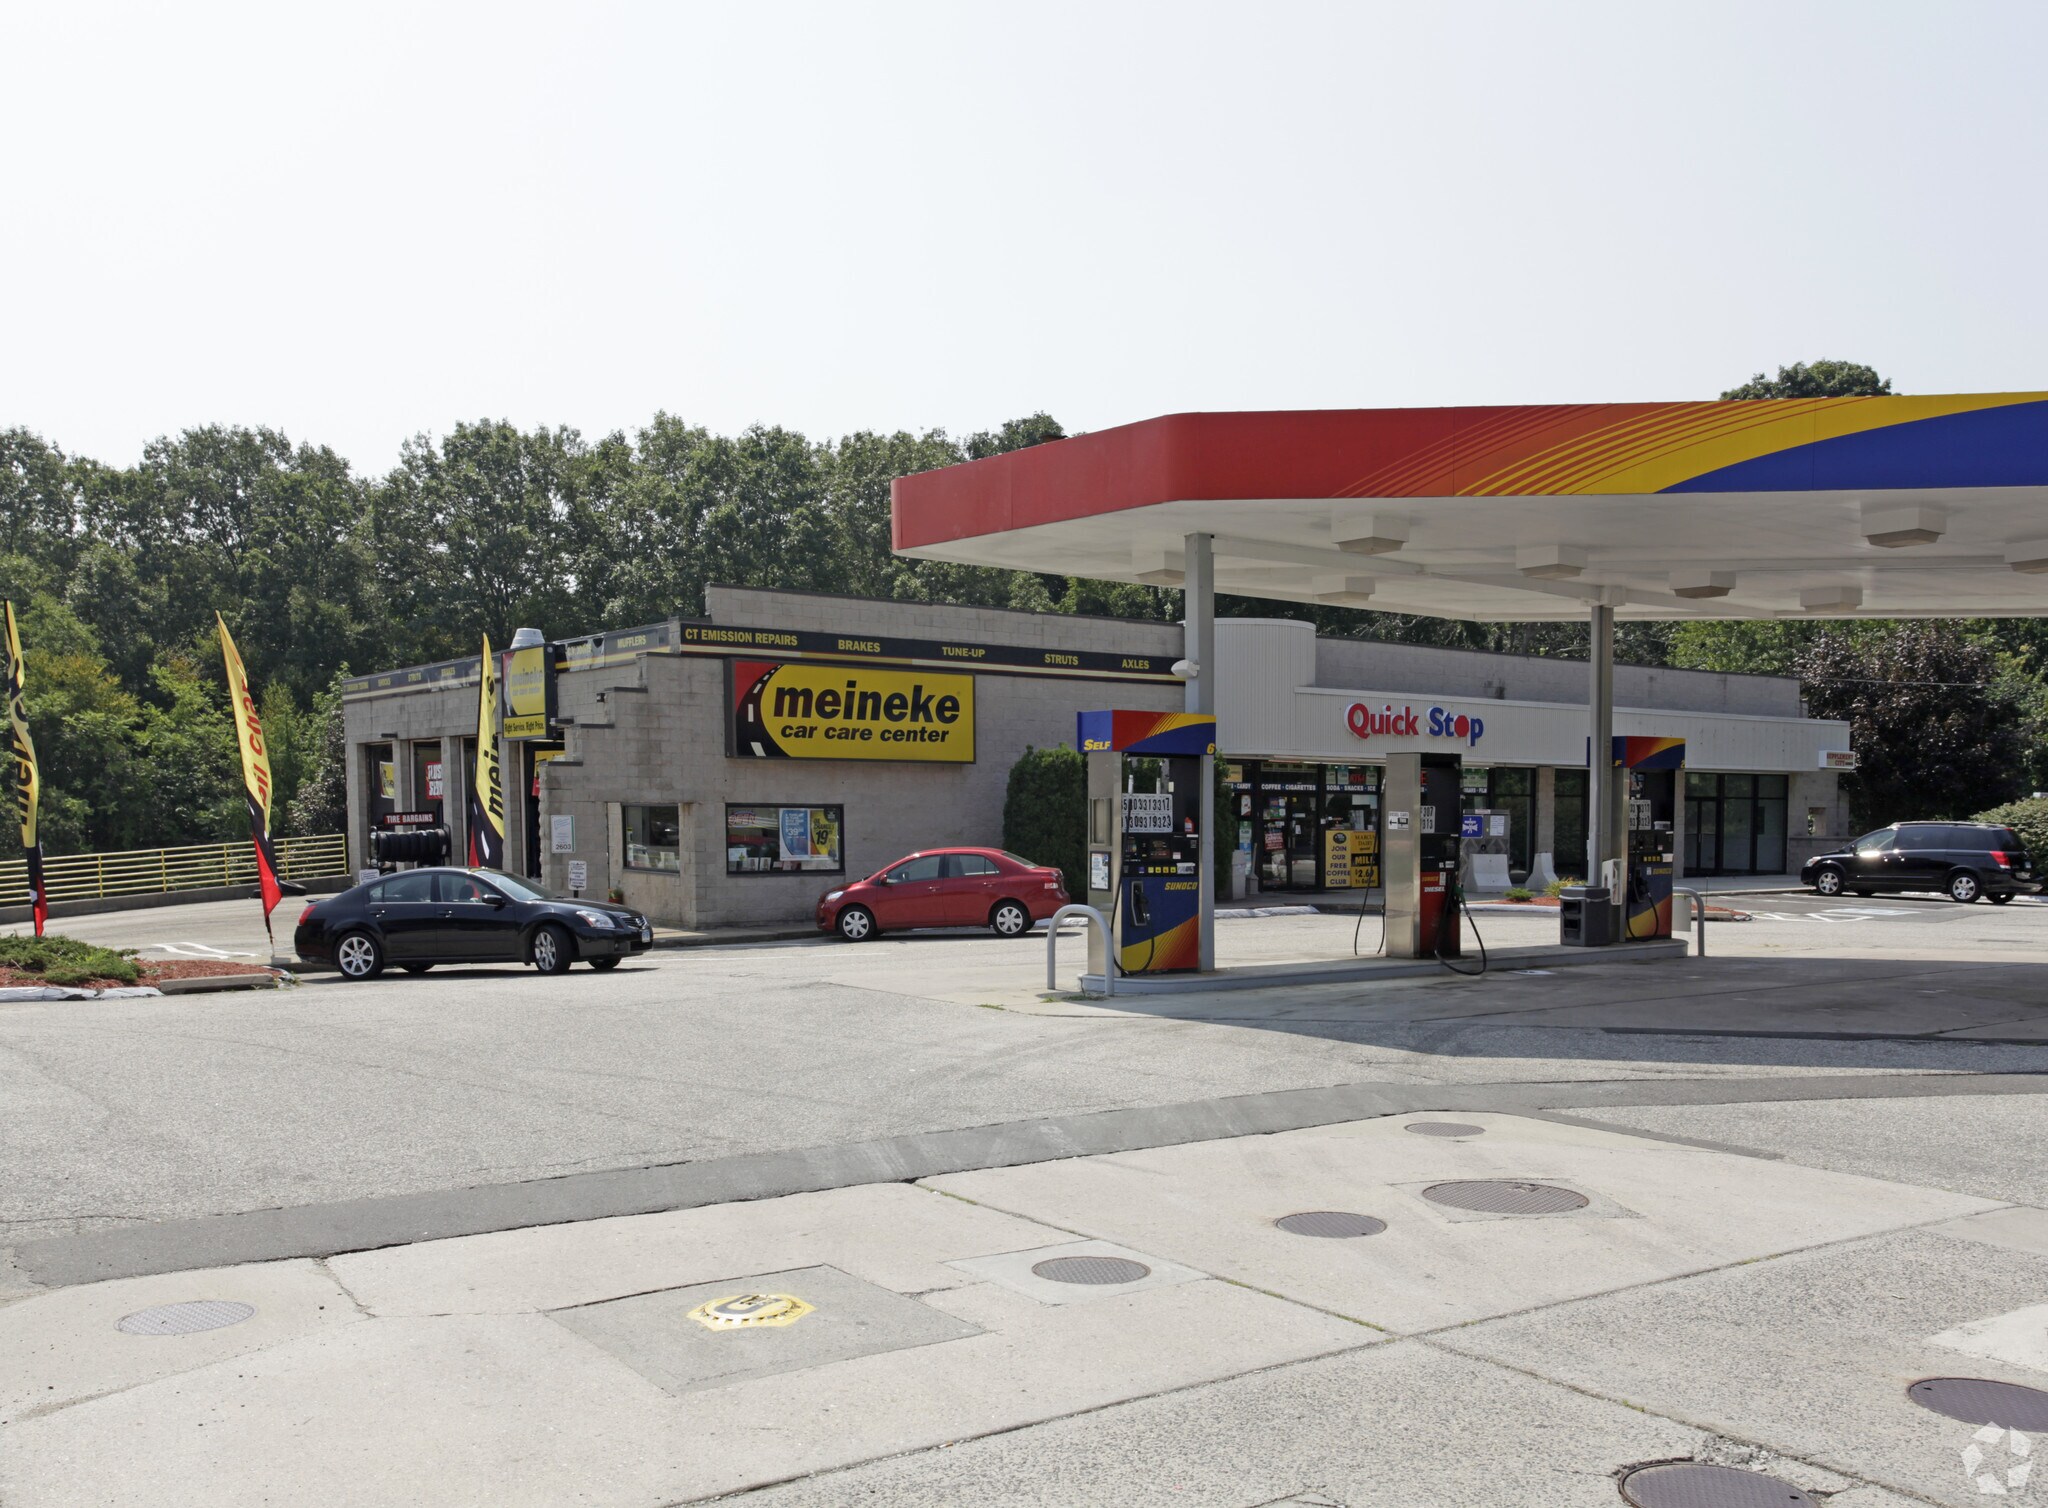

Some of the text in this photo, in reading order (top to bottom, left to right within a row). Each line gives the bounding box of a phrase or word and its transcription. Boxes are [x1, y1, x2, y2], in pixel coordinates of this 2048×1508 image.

[616, 634, 647, 648] MUFFLERS
[685, 628, 798, 647] CT EMISSION REPAIRS
[837, 640, 881, 653] BRAKES
[942, 646, 986, 658] TUNE-UP
[1044, 654, 1079, 666] STRUTS
[1121, 659, 1150, 669] AXLES
[773, 680, 961, 724] meineke
[1346, 703, 1484, 746] Quick Stop
[781, 725, 950, 743] car care center
[1083, 739, 1111, 751] SELF
[1206, 743, 1216, 755] 6
[386, 813, 433, 824] TIRE BARGAINS
[1164, 881, 1198, 891] SUNOCO
